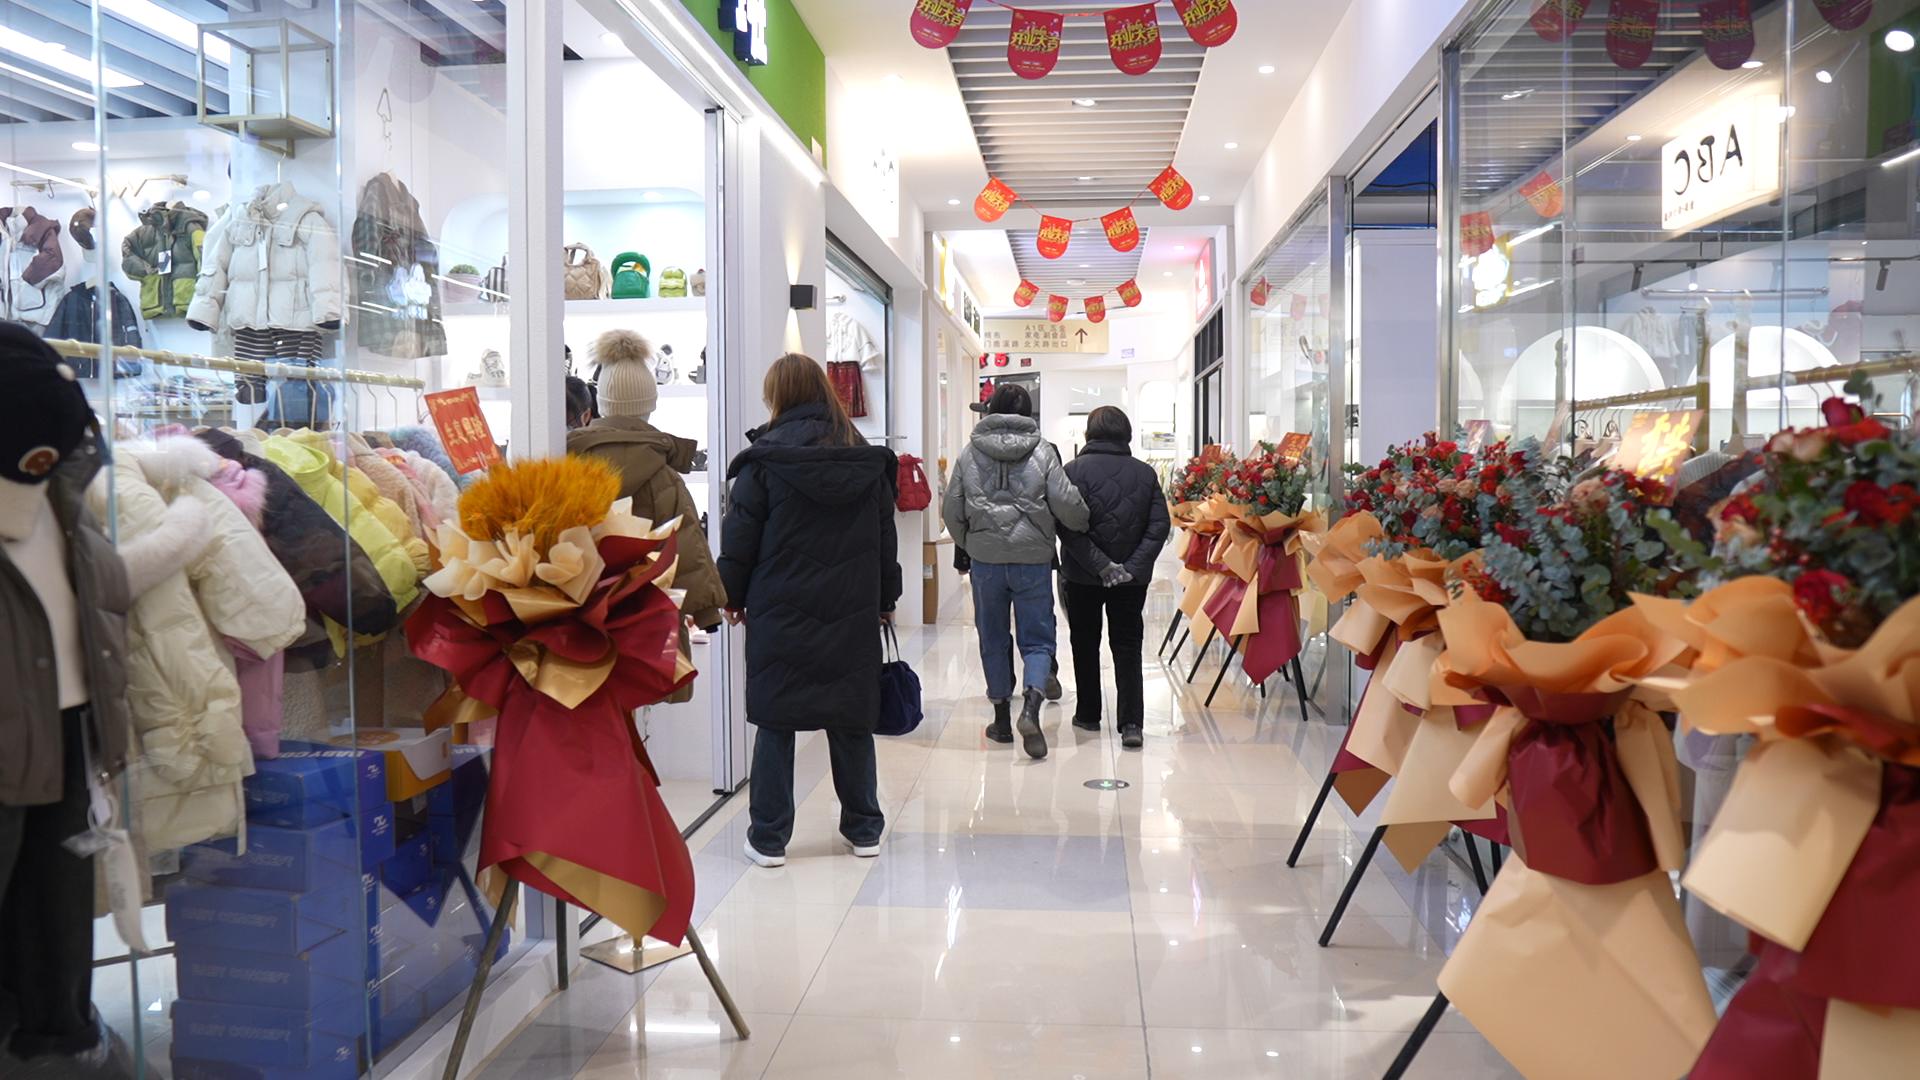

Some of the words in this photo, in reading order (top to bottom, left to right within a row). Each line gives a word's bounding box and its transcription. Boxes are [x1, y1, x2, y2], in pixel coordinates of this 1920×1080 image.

[1010, 28, 1061, 52] 开业大吉
[1110, 25, 1159, 49] 开业大吉
